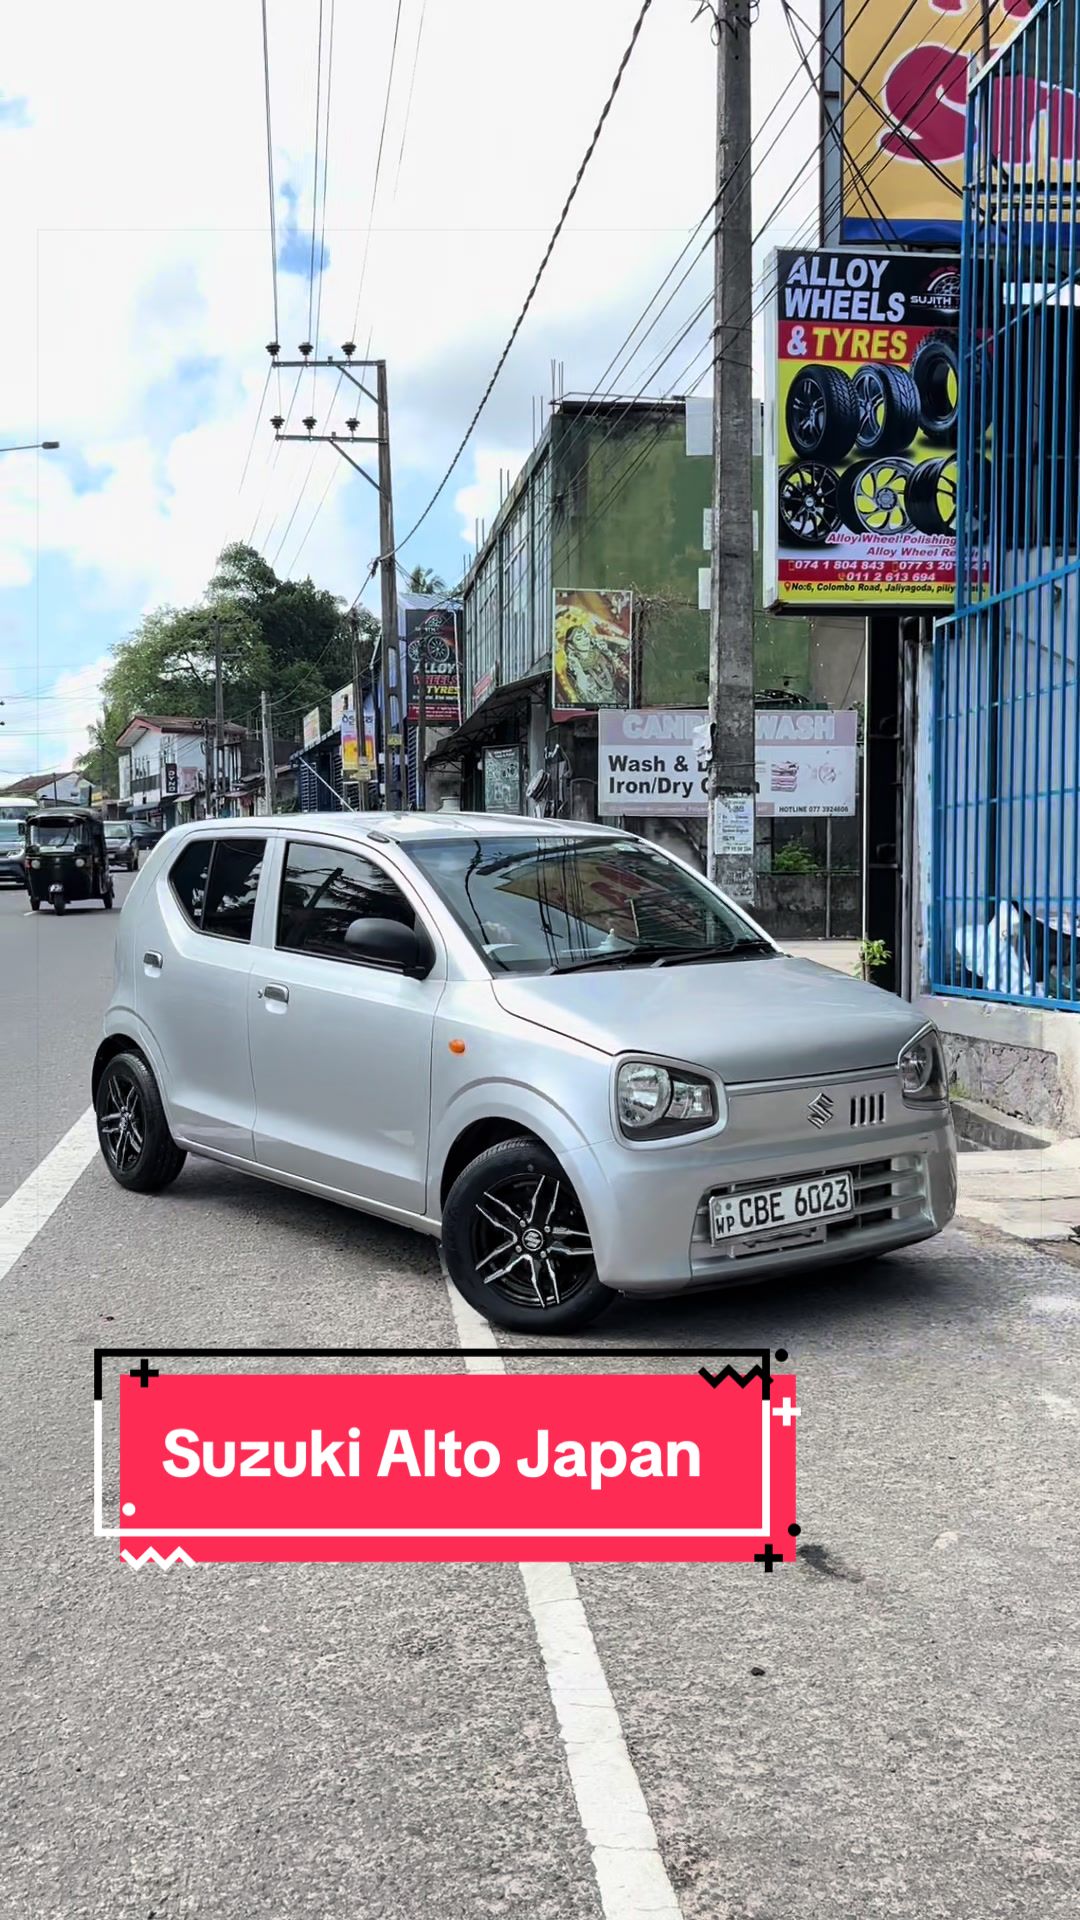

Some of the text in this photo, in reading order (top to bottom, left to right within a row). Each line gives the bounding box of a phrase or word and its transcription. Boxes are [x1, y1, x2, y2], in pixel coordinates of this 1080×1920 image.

[787, 256, 889, 288] ALLOY
[785, 288, 905, 322] WHEELS
[910, 296, 951, 305] SUJITH
[787, 325, 908, 360] & TYRES
[827, 533, 860, 543] Alloy
[862, 534, 898, 545] Wheel
[867, 547, 897, 556] Alloy
[901, 547, 938, 557] Wheel
[795, 560, 819, 569] 074
[823, 561, 830, 569] 1
[834, 561, 857, 570] 804
[861, 561, 885, 570] 843
[899, 562, 924, 570] 077
[926, 562, 934, 570] 3
[846, 572, 935, 582] 011 2 613 694
[817, 583, 855, 591] Colombo
[858, 584, 882, 593] Road,
[755, 715, 835, 740] WASH
[608, 755, 665, 773] Wash
[673, 755, 688, 772] &
[608, 777, 693, 798] Iron/Dry
[739, 1179, 848, 1228] CBE 6023
[715, 1215, 735, 1234] WP
